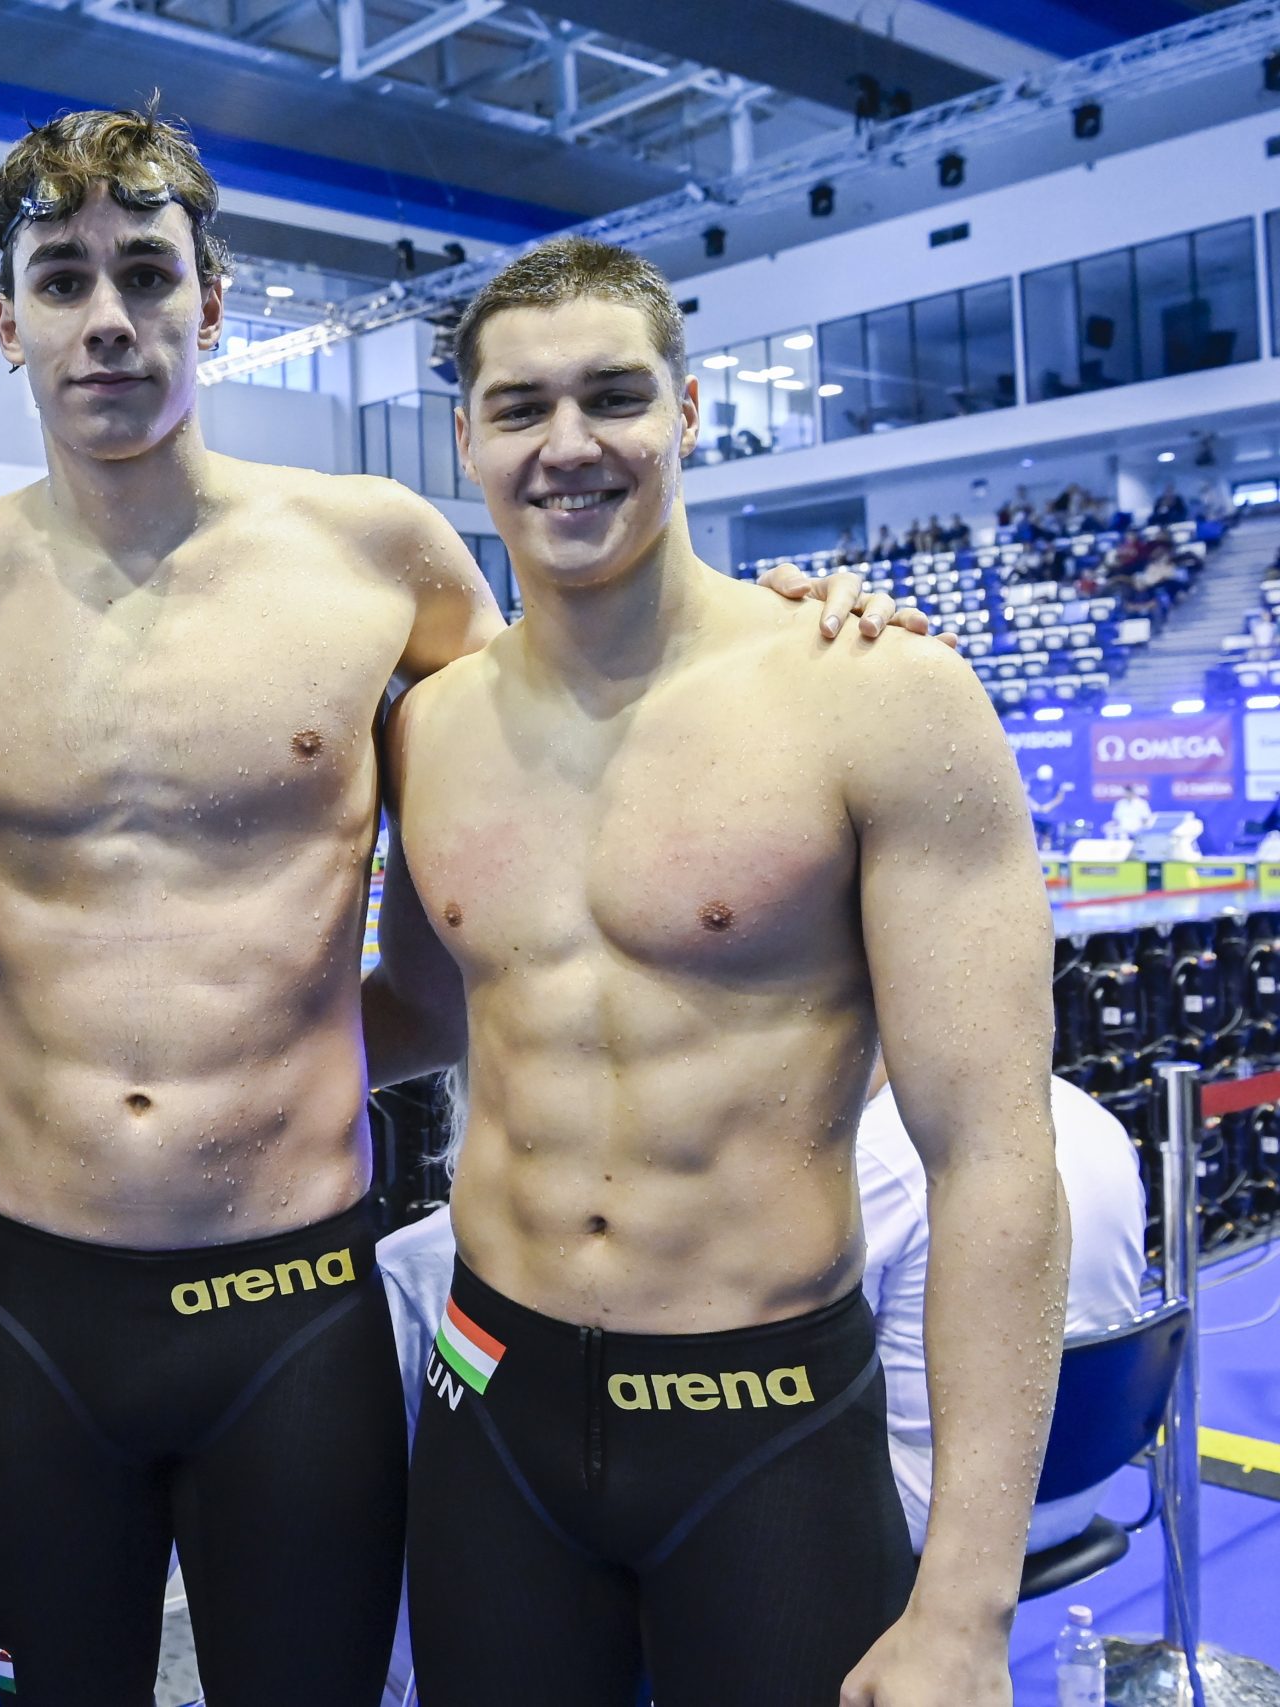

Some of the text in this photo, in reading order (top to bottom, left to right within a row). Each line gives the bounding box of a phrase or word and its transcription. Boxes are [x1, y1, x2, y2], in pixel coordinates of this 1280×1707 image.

[1128, 735, 1225, 761] OMEGA
[171, 1248, 355, 1315] arena
[608, 1365, 815, 1411] arena
